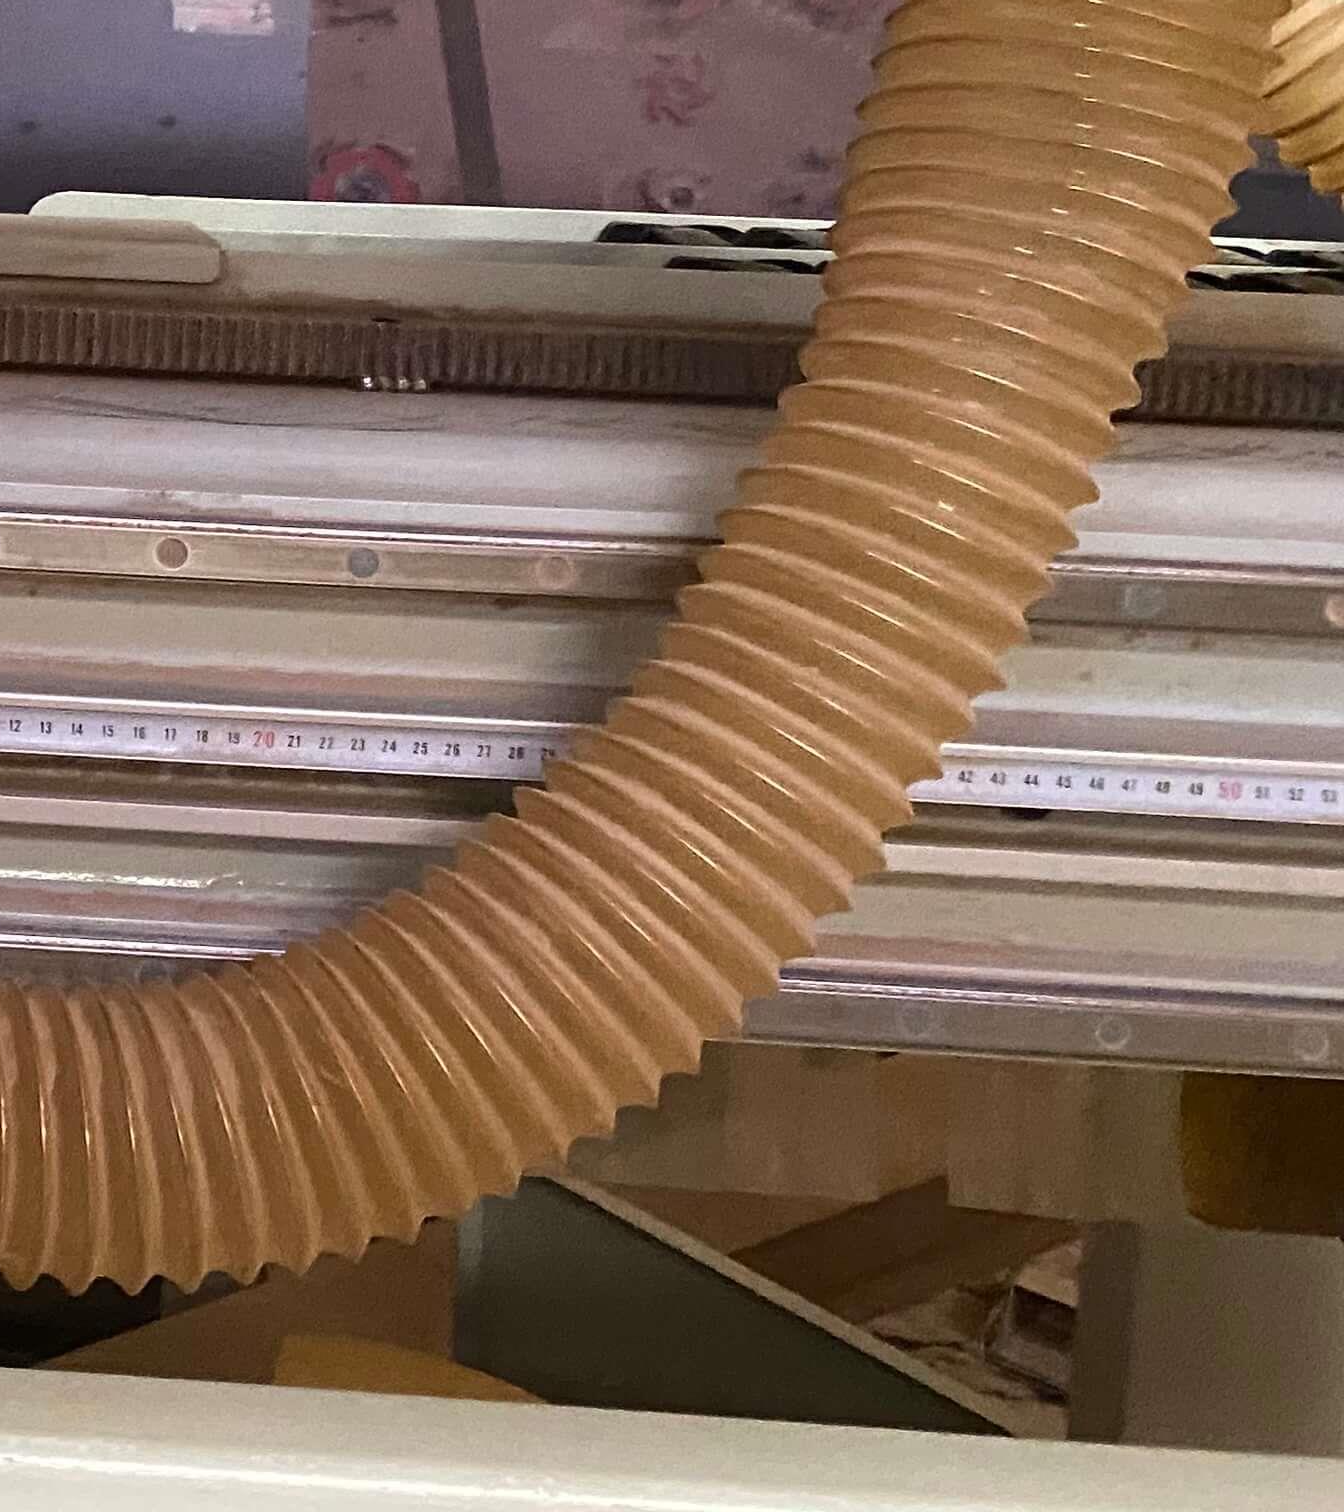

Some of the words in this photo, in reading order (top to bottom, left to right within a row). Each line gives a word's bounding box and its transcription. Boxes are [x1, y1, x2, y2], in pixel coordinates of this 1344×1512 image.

[9, 719, 22, 732] 12
[40, 721, 52, 734] 13
[71, 723, 83, 735] 14
[102, 724, 114, 737] 15
[133, 726, 145, 739] 16
[164, 728, 176, 741] 17
[196, 730, 208, 743] 18
[228, 732, 240, 744] 19
[254, 730, 275, 748] 20
[287, 735, 301, 748] 21
[319, 737, 334, 750] 22
[350, 738, 365, 751] 23
[382, 739, 396, 752] 24
[413, 741, 428, 755] 25
[444, 743, 460, 756] 26
[476, 745, 491, 758] 27
[1024, 774, 1038, 785] 44
[1056, 775, 1071, 788] 45
[1217, 780, 1242, 800] 50
